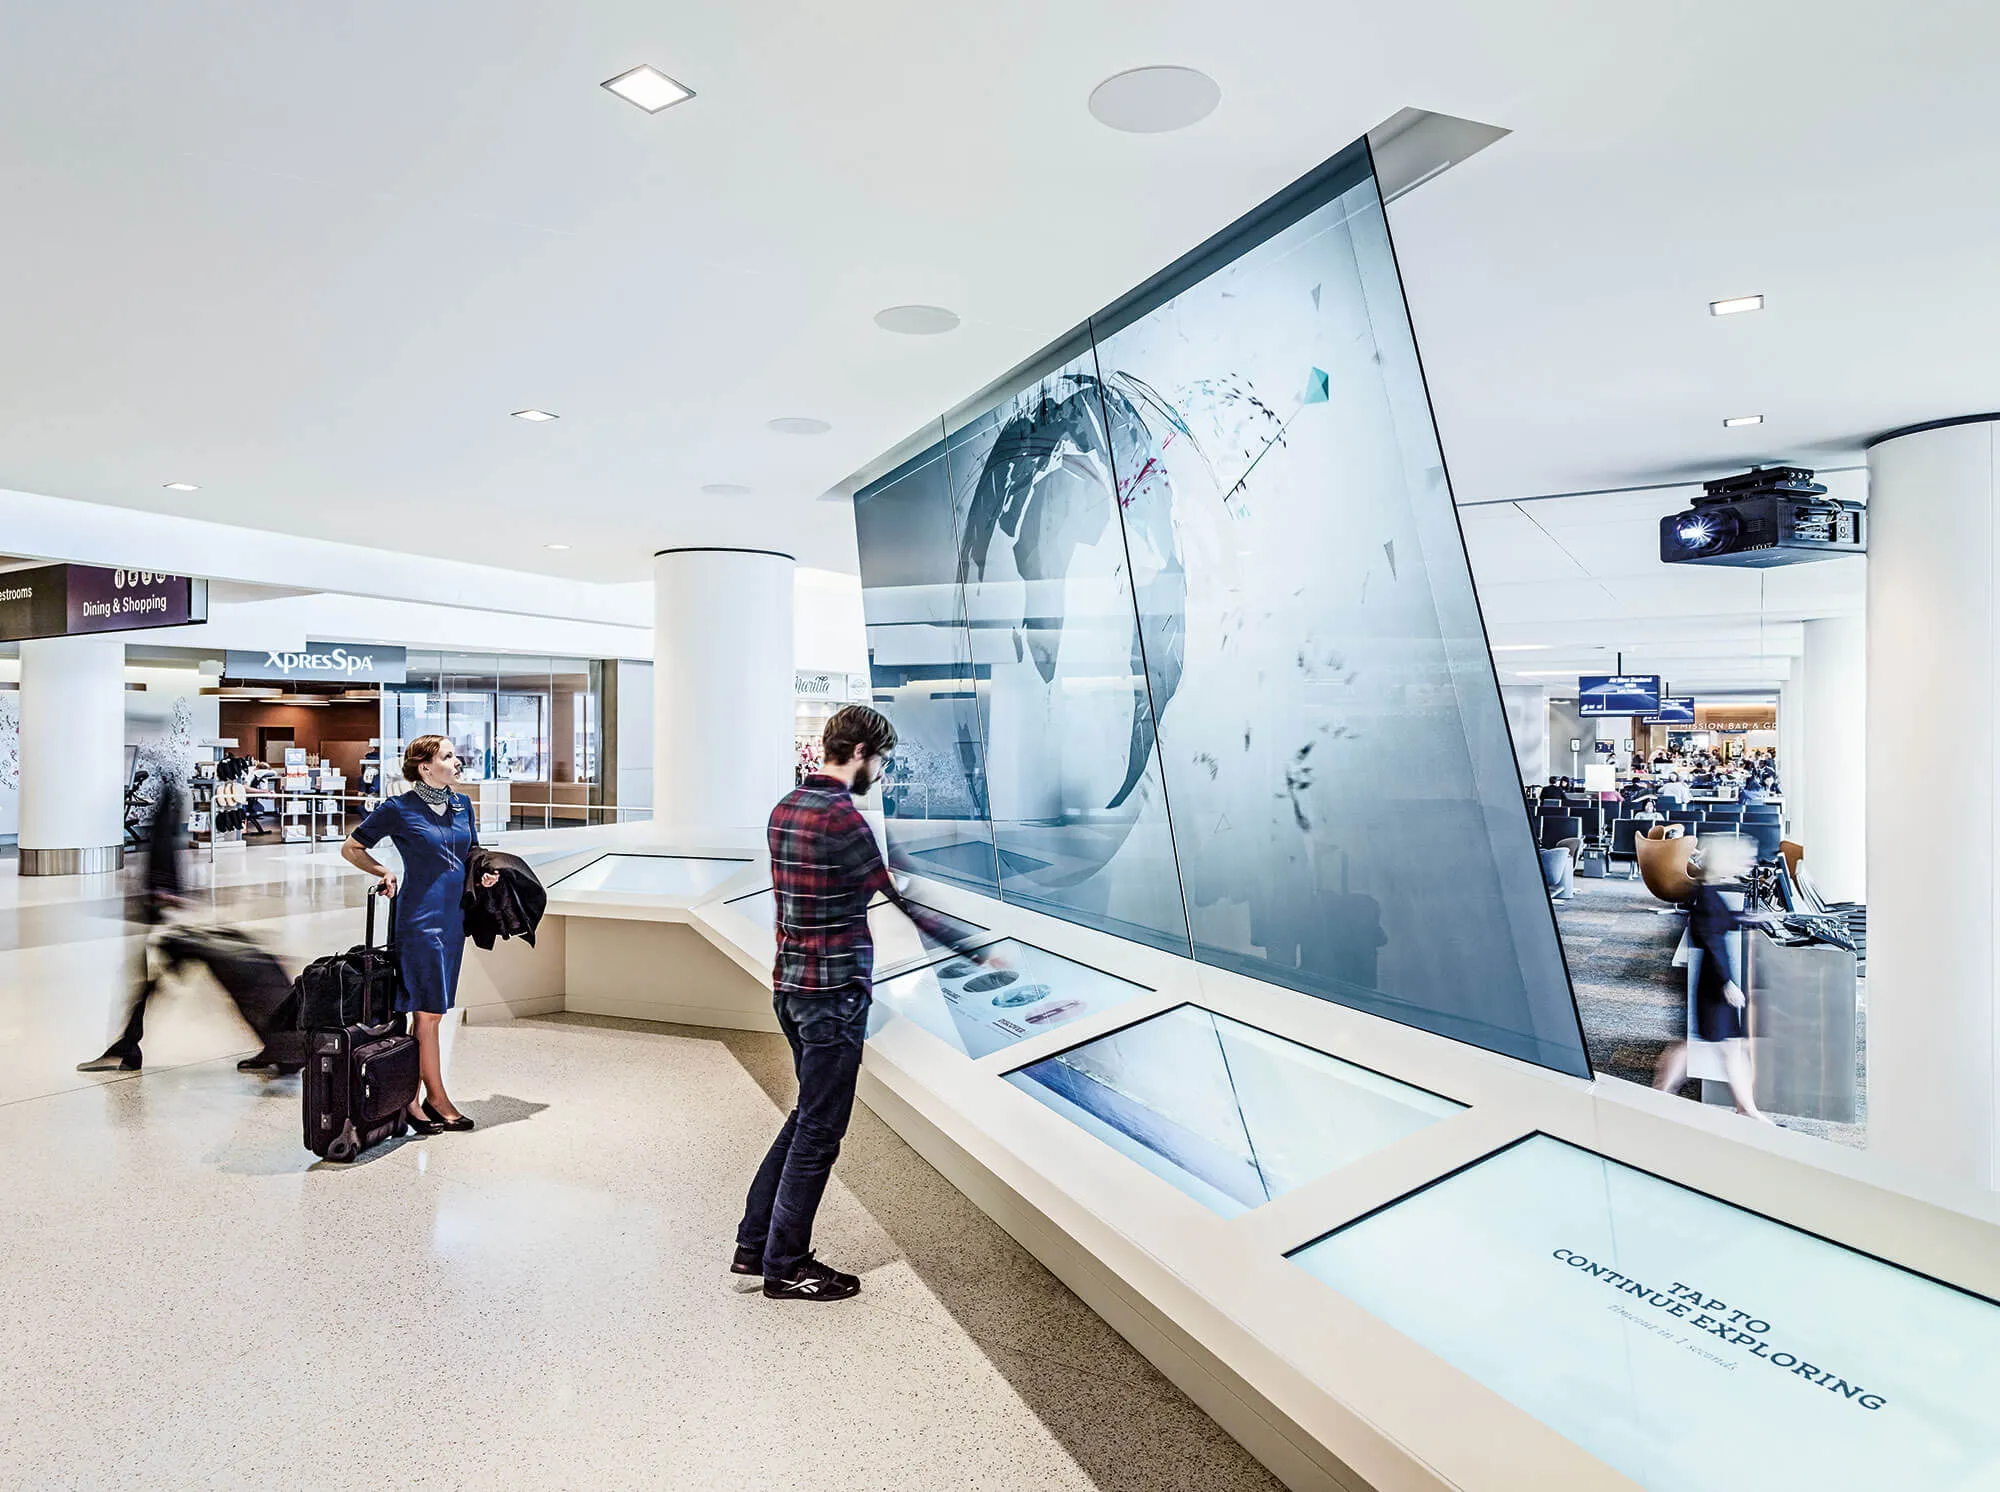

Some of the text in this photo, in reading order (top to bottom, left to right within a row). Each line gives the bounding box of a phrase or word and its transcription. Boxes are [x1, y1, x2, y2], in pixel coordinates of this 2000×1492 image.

[0, 587, 33, 602] estrooms
[83, 595, 167, 618] Dining & Shopping
[1680, 722, 1724, 730] MISSION
[1728, 722, 1748, 730] BAR
[1763, 722, 1776, 730] GR
[1667, 1282, 1771, 1334] TAP TO
[1552, 1248, 1888, 1412] CONTINUE EXPLORING
